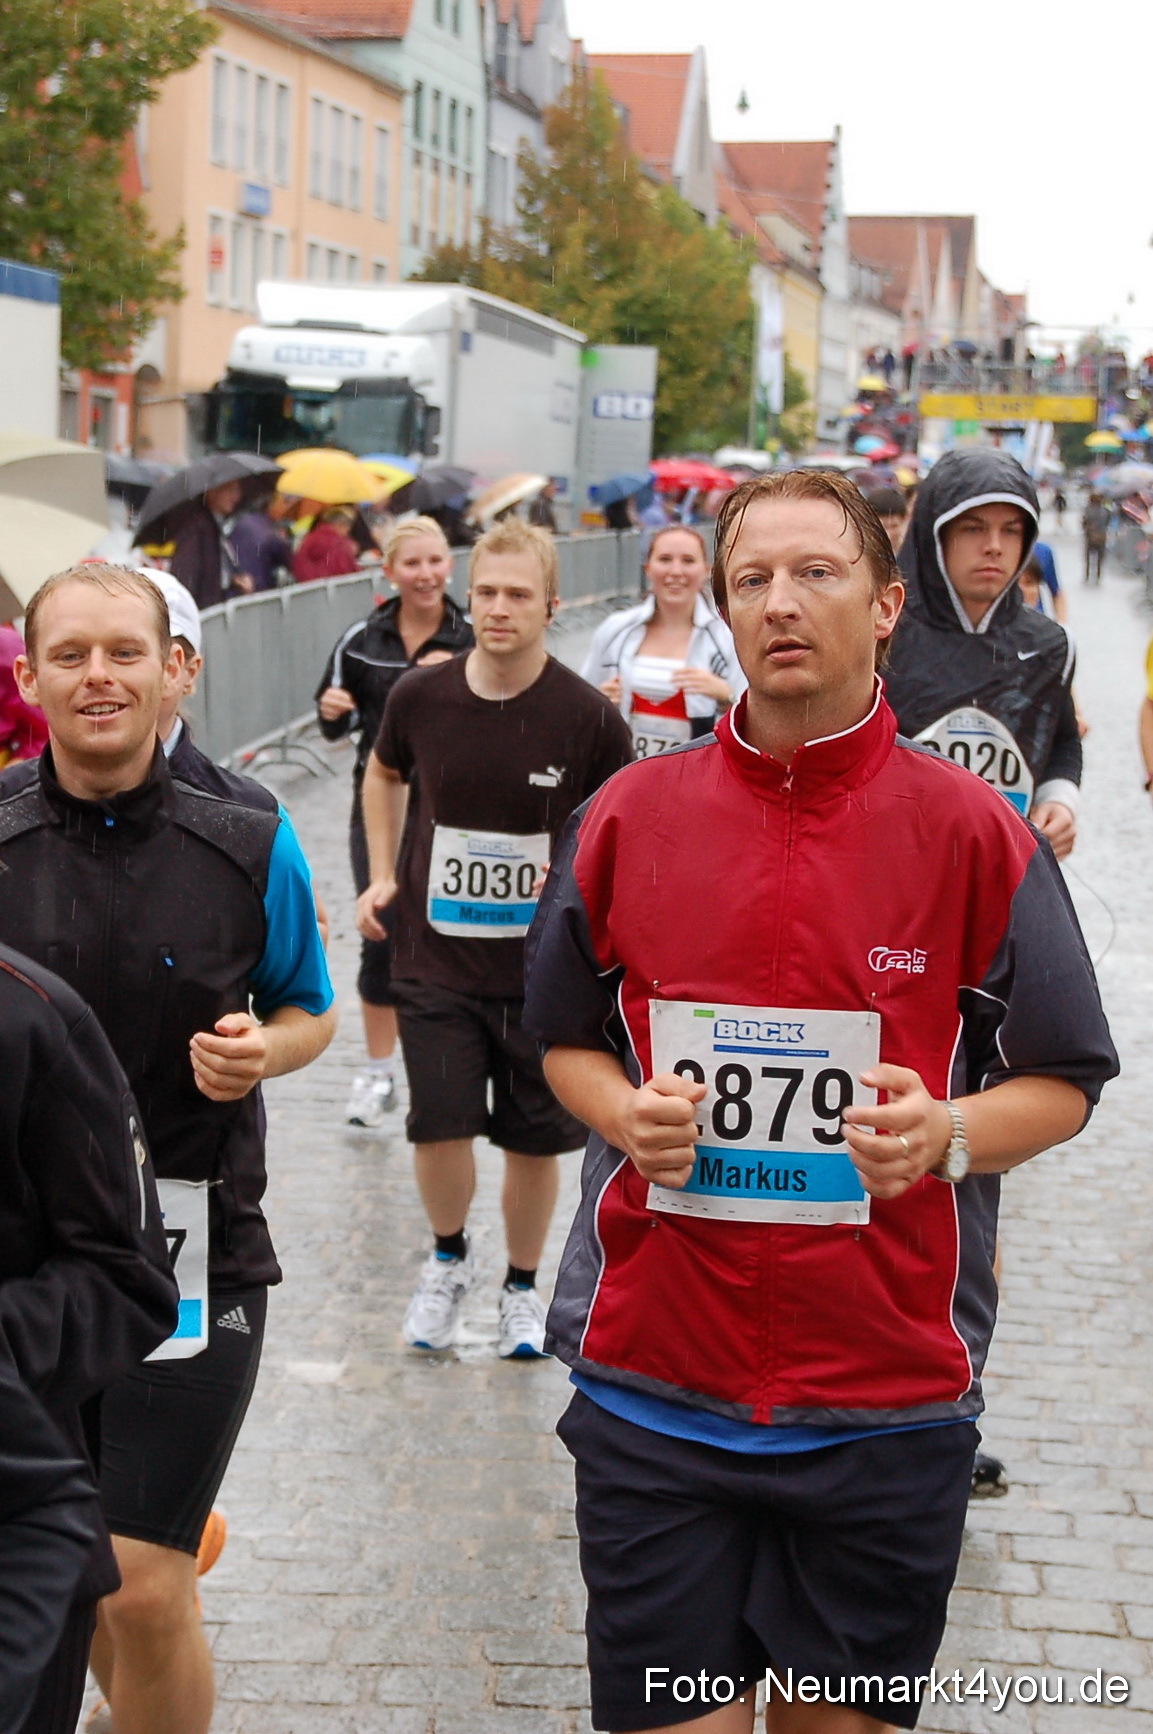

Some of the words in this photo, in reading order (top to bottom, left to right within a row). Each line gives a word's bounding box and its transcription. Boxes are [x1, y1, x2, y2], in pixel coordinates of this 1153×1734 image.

[636, 737, 681, 758] 87
[443, 858, 536, 899] 3030
[459, 906, 514, 922] Marcus
[713, 1019, 805, 1043] BOCK
[699, 1157, 807, 1193] Markus
[216, 1318, 251, 1334] adidas
